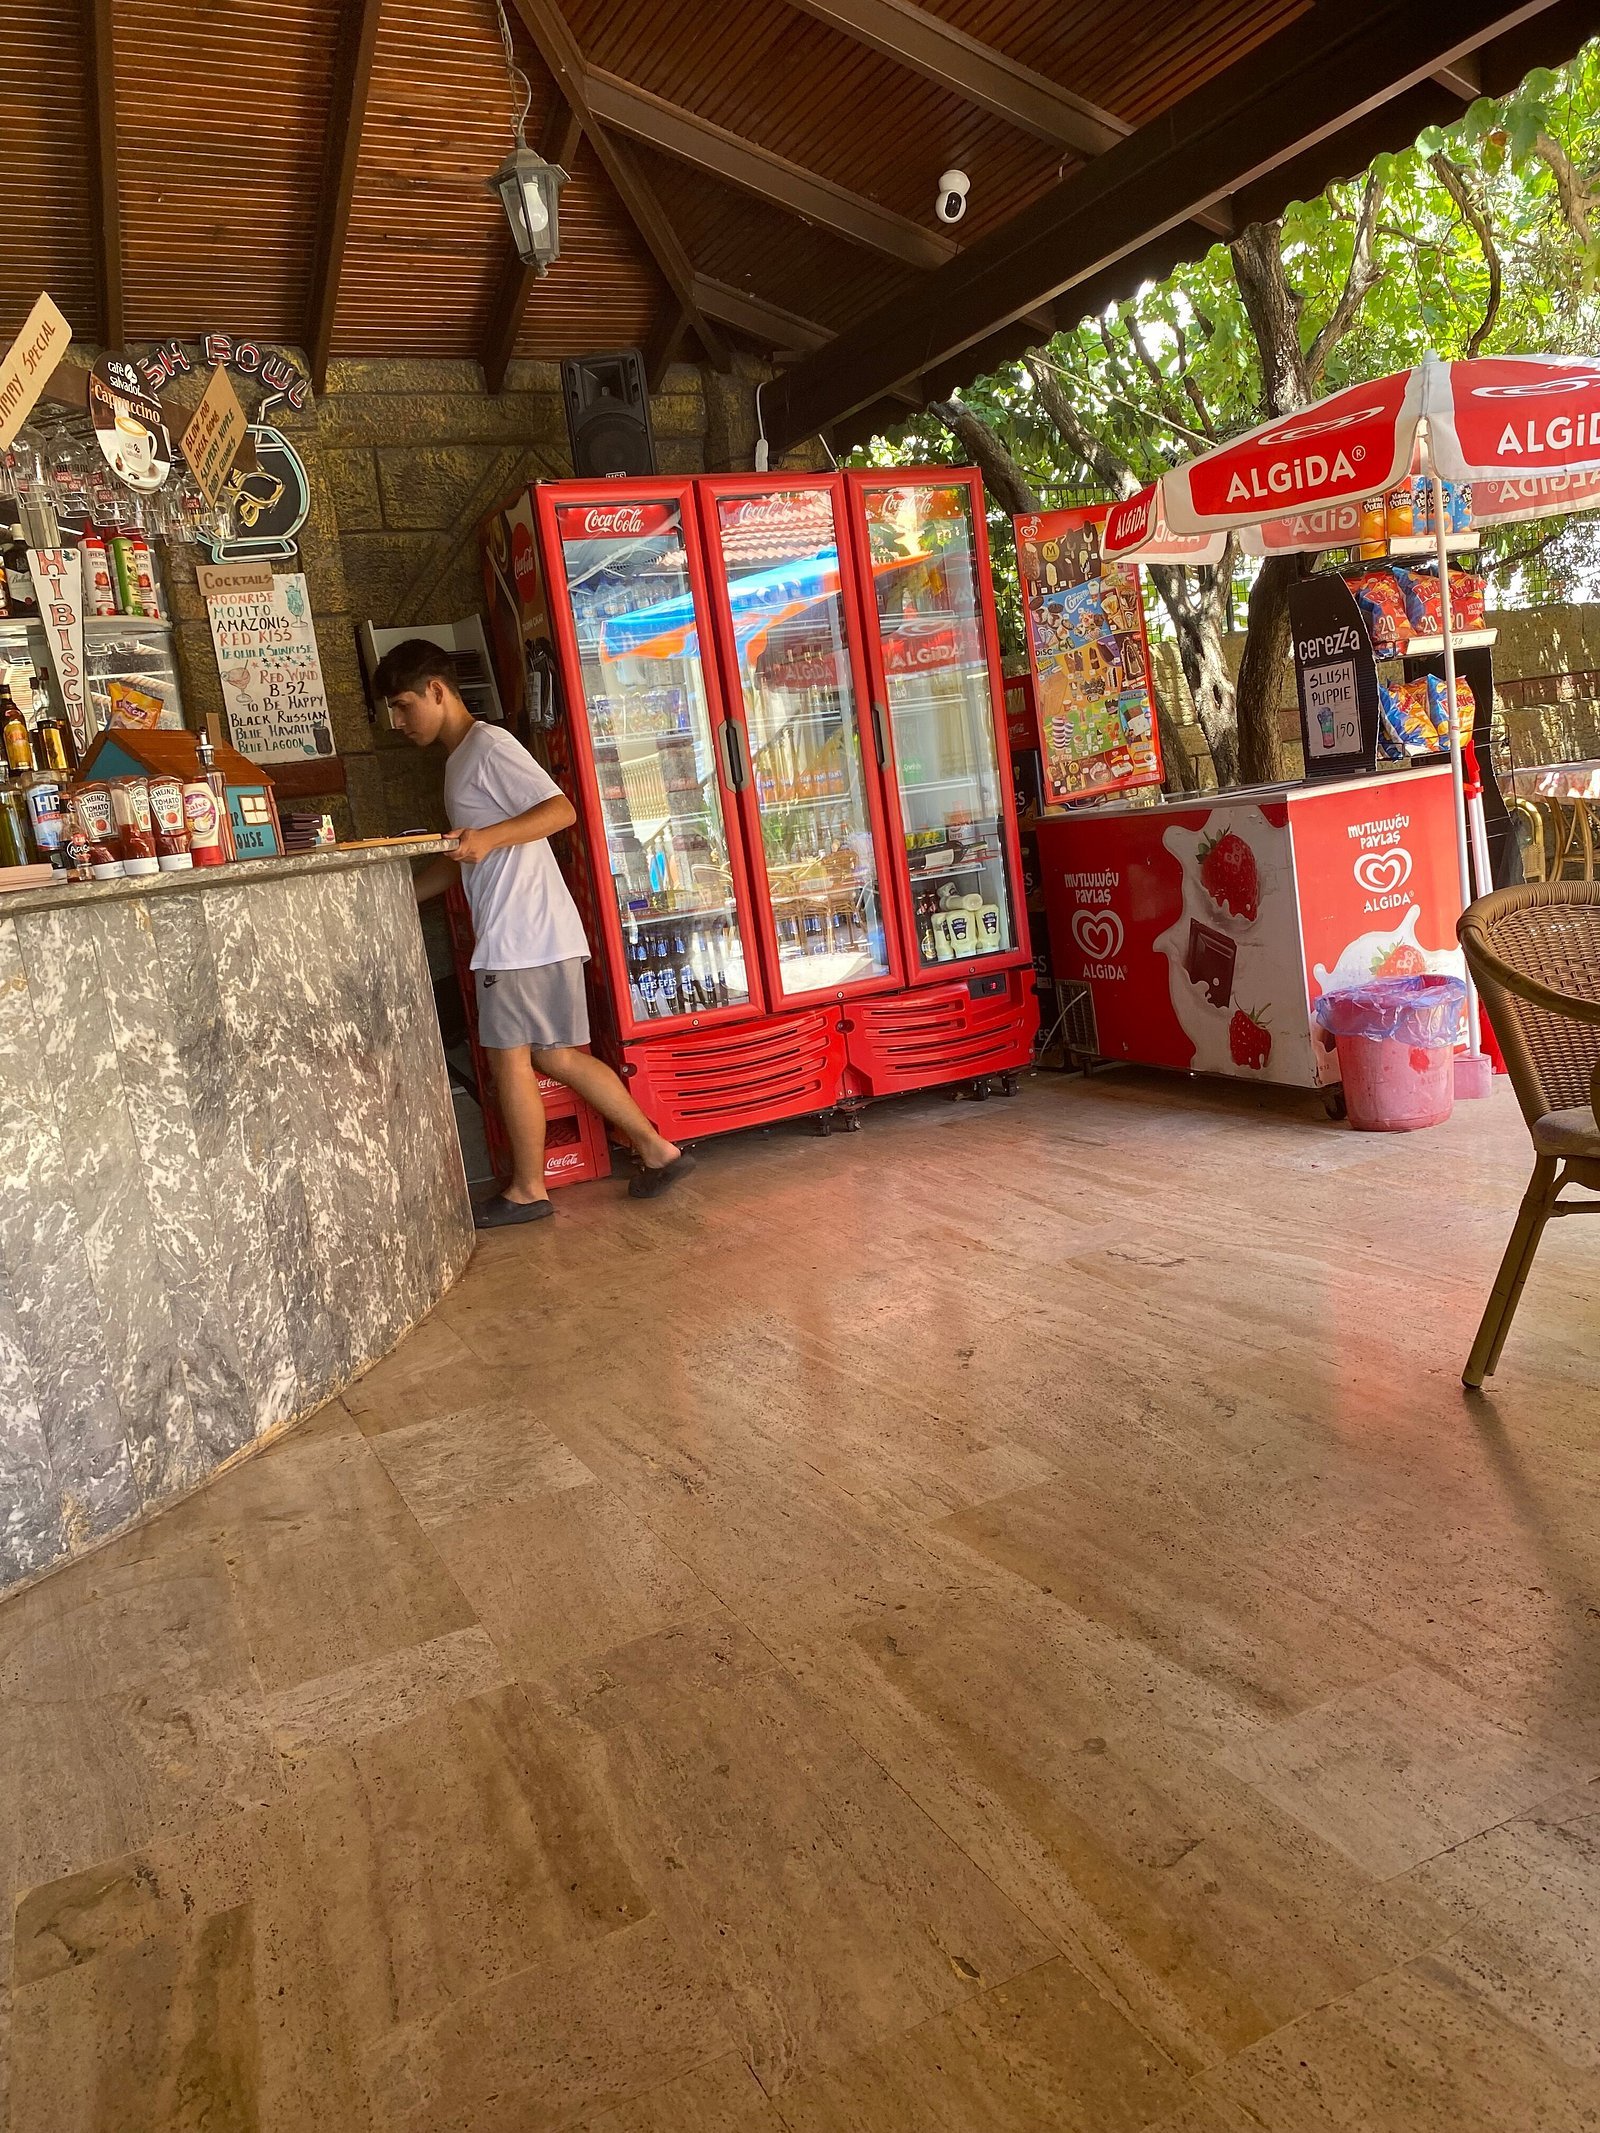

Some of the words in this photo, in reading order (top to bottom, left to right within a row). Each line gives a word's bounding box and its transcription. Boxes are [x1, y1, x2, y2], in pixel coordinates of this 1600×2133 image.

[22, 320, 56, 375] SPECIAL
[137, 342, 190, 391] SH
[204, 333, 308, 409] BOWL
[94, 384, 161, 423] Cappuccino
[185, 418, 201, 452] BLOW
[199, 399, 210, 424] JOB
[205, 410, 220, 437] BOMB
[200, 438, 220, 487] SLIPPERY
[217, 407, 235, 442] NIPPLE
[1226, 449, 1357, 503] ALGiDA
[1389, 496, 1412, 509] Potato
[584, 508, 644, 533] Coca-Cola
[1114, 507, 1147, 541] ALGiDA
[203, 572, 274, 590] COCKTAILS
[208, 592, 273, 606] MOONRISE
[213, 604, 271, 619] MOJITO
[216, 616, 290, 633] AMAZONIS
[1378, 615, 1396, 635] 20
[1420, 615, 1438, 634] 20
[220, 632, 252, 646] RED
[258, 629, 292, 643] KISS
[35, 550, 86, 756] HIBISCUS
[266, 644, 314, 657] SUNRISE
[259, 670, 285, 684] RED
[1309, 667, 1350, 688] SLUSH
[243, 703, 258, 712] TO
[262, 697, 282, 712] BE
[287, 695, 324, 709] HAPPY
[1311, 686, 1351, 706] PUPPIE
[230, 712, 271, 727] BLACK
[277, 709, 328, 723] RUSSIAN
[235, 727, 262, 740] BLUE
[1336, 721, 1355, 739] 150
[237, 740, 263, 754] BLUE
[86, 795, 105, 803] HEINZ
[155, 788, 175, 796] HEINZ
[155, 797, 179, 805] TOMATO
[34, 794, 60, 812] HP
[85, 803, 109, 813] TOMATO
[88, 810, 109, 818] KETCHUP
[1347, 813, 1410, 839] MUTLULUĞU
[1360, 830, 1401, 850] PAYLAŞ
[1064, 868, 1119, 888] MUTLULUĞU
[1075, 889, 1112, 906] PAYLAŞ
[1363, 892, 1411, 914] ALGiDA
[1083, 963, 1126, 981] ALGiDA
[640, 979, 657, 990] EFES
[659, 977, 677, 988] EFES
[546, 1153, 578, 1170] Coca-Cola
